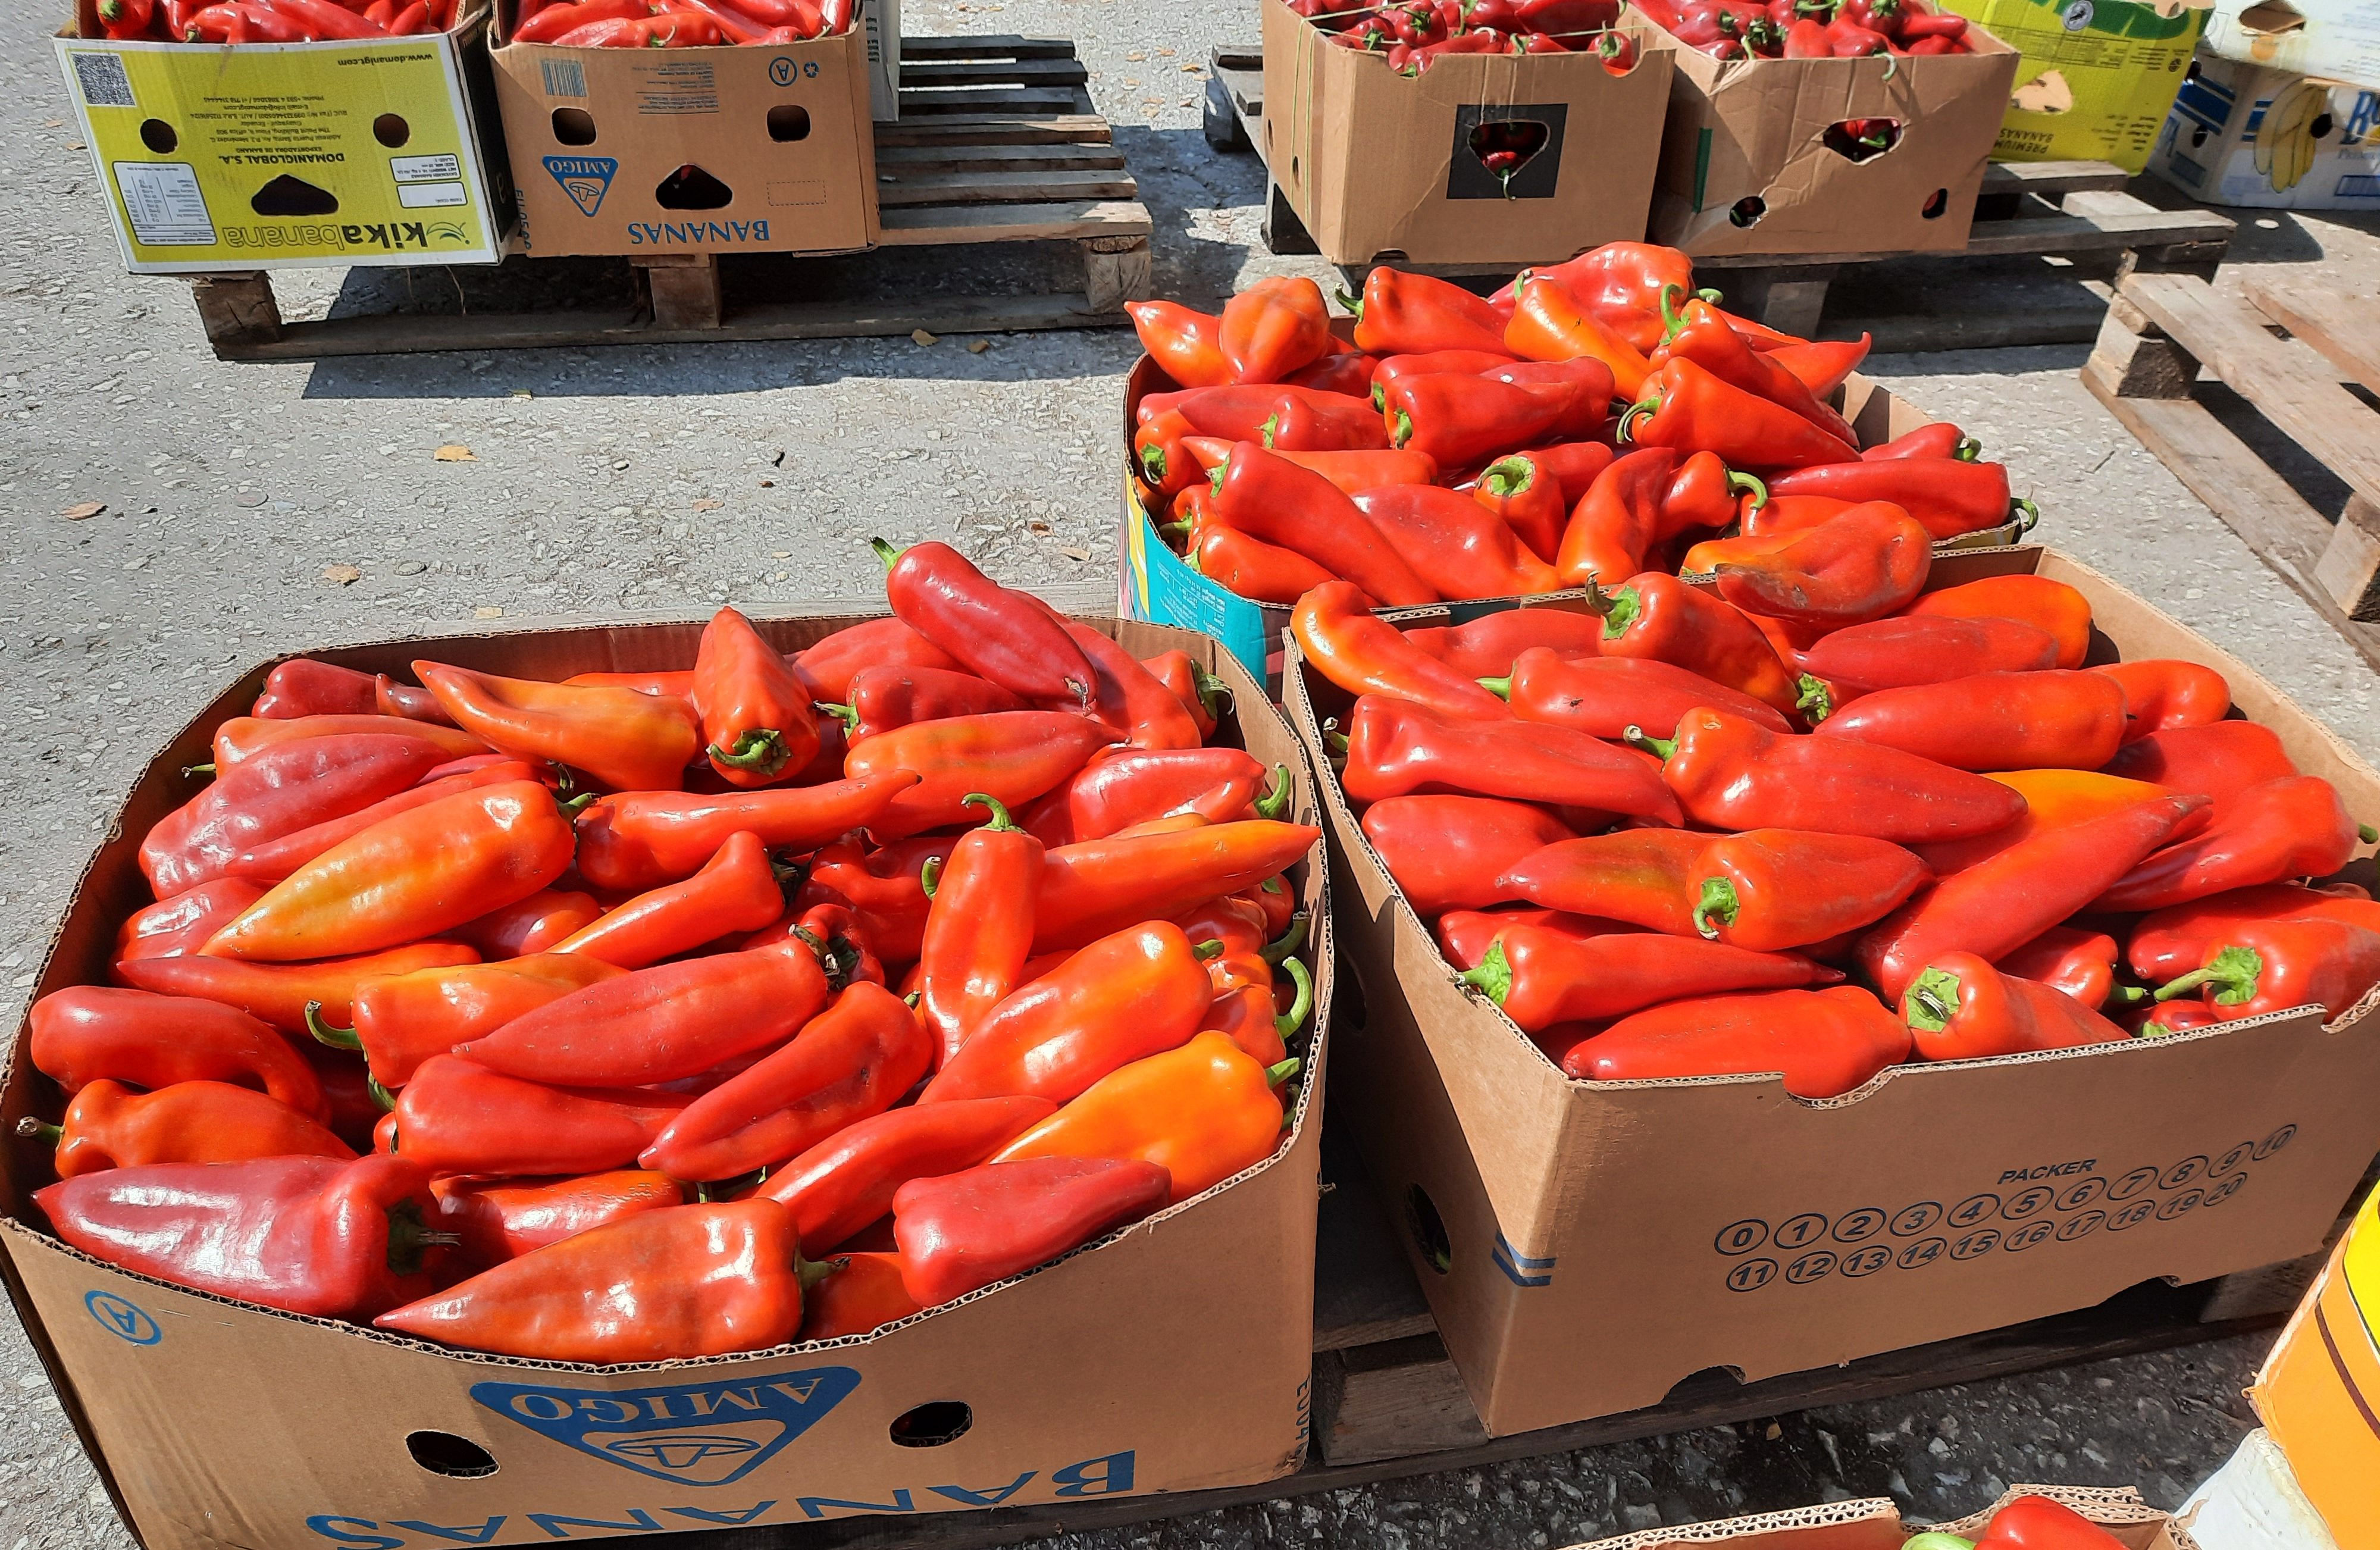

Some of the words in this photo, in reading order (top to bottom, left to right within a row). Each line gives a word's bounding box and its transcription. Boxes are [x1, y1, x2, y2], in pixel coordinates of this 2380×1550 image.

[338, 54, 433, 67] www.domanigt.com
[1999, 129, 2054, 143] BANANAS
[218, 155, 242, 164] S.A.
[245, 152, 345, 163] DOMANIGLOBAL
[550, 160, 610, 174] AMIGO
[628, 220, 769, 244] BANANAS
[1206, 627, 1220, 639] TOTAL
[1997, 1158, 2097, 1185] PACKER
[1736, 1264, 1770, 1286] 11
[1792, 1257, 1831, 1278] 12
[1849, 1252, 1886, 1272] 13
[1905, 1242, 1941, 1264] 14
[1958, 1235, 1997, 1255] 15
[2015, 1226, 2050, 1245] 16
[2066, 1216, 2102, 1235] 17
[2117, 1205, 2152, 1224] 18
[2168, 1195, 2200, 1214] 19
[2208, 1178, 2243, 1201] 20
[510, 1377, 824, 1423] AMIGO
[305, 1450, 1135, 1550] BANANAS
